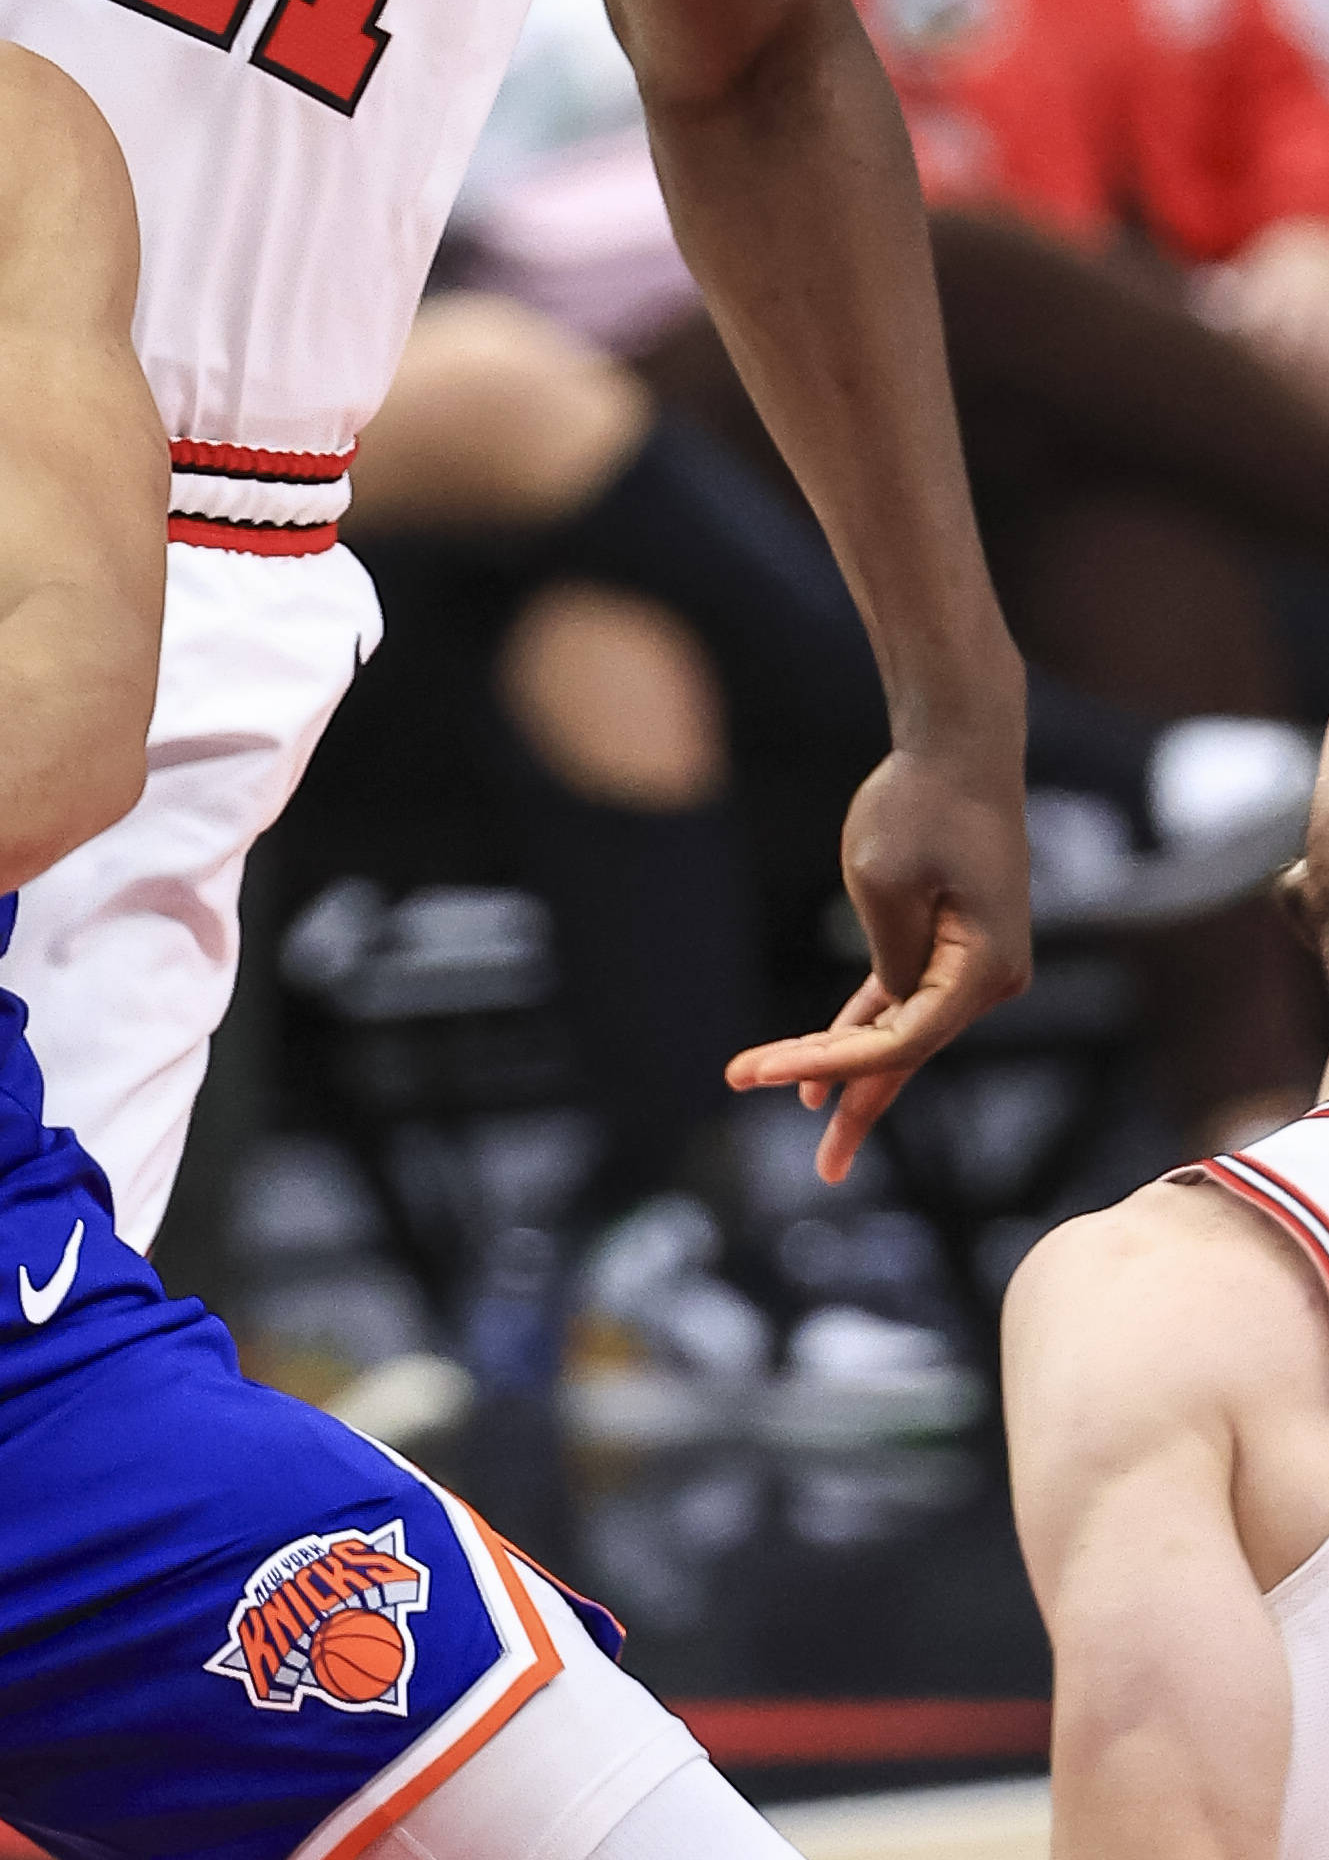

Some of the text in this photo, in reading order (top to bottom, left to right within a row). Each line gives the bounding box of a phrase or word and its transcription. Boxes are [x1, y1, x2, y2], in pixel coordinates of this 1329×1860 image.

[237, 1537, 421, 1701] KNICKS
[253, 1543, 326, 1605] NEW YORK
